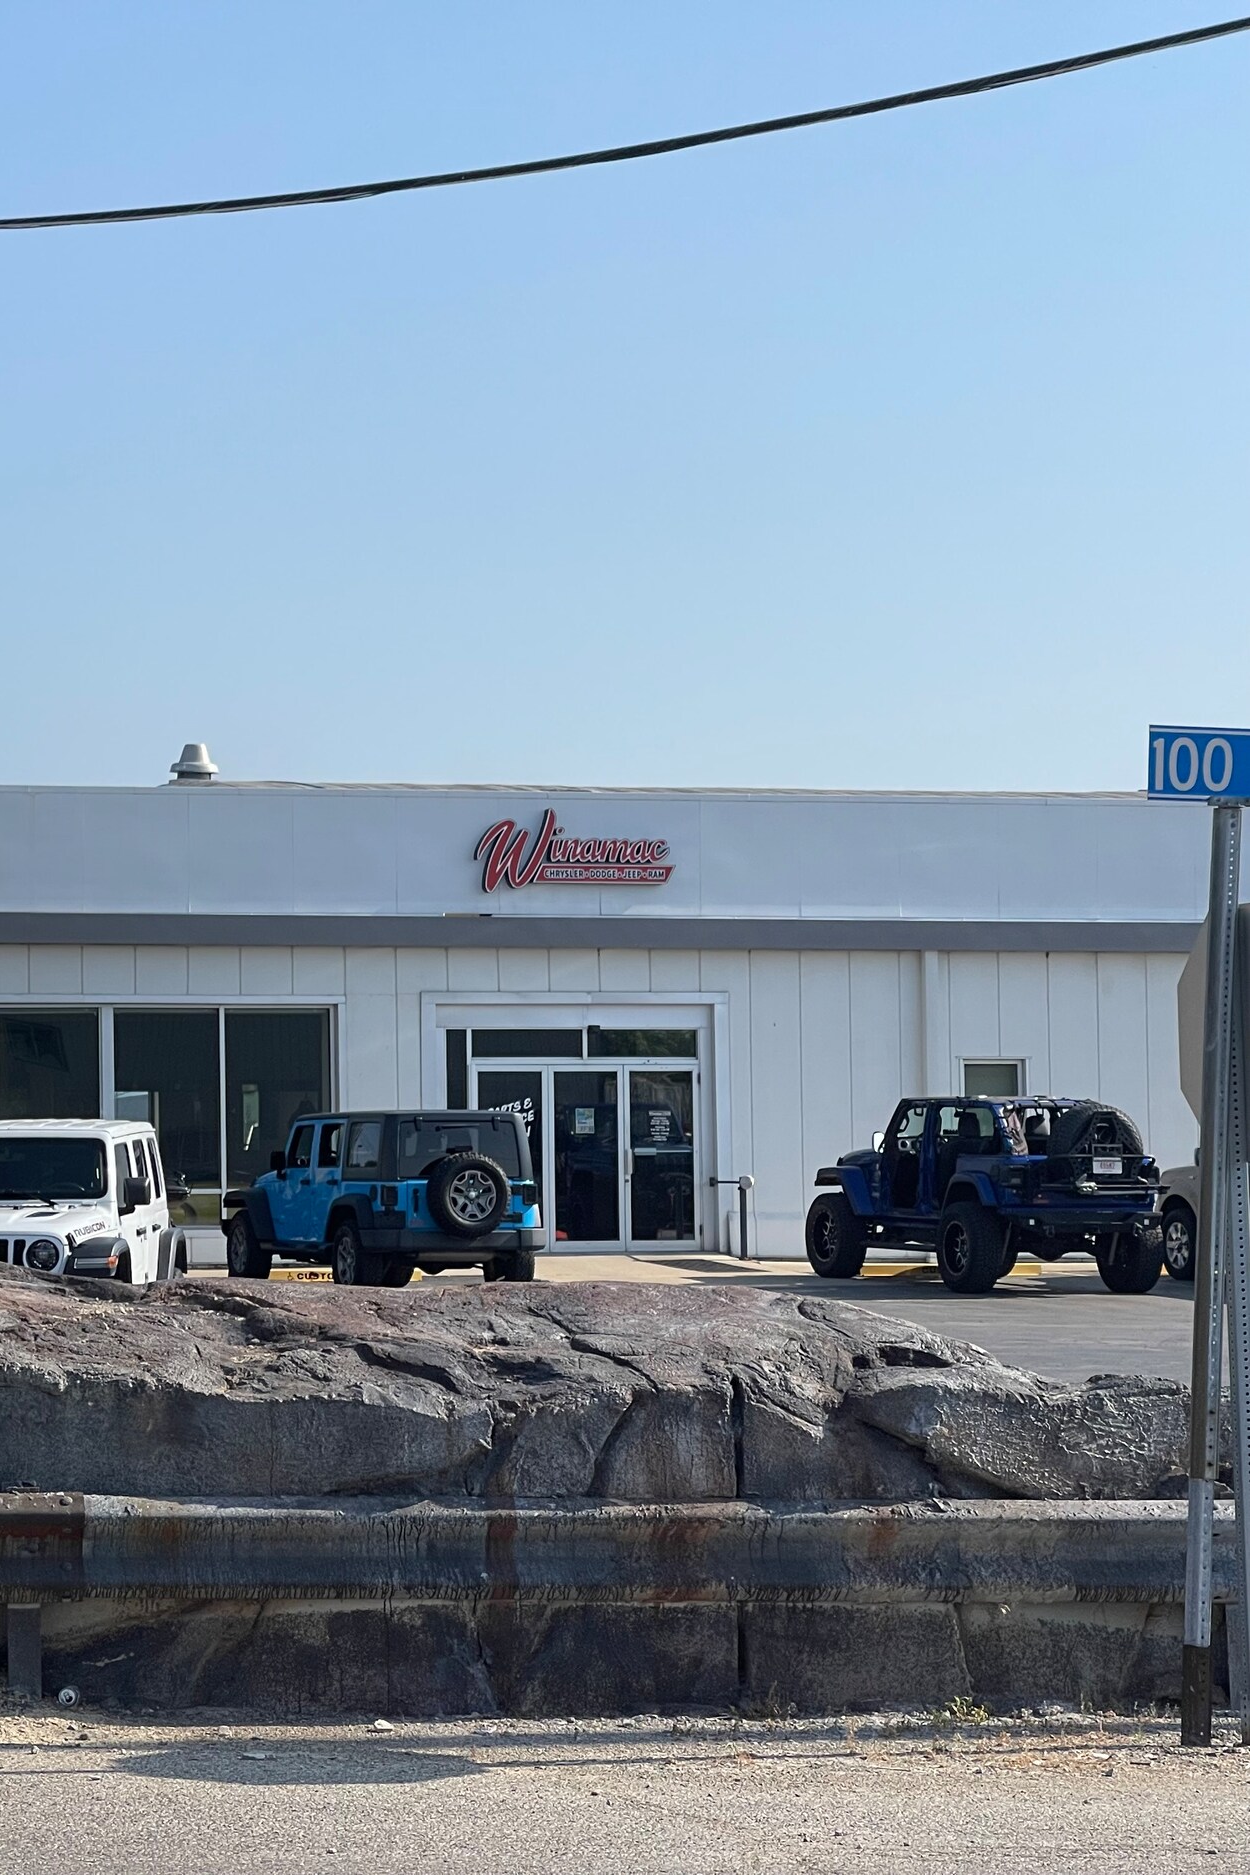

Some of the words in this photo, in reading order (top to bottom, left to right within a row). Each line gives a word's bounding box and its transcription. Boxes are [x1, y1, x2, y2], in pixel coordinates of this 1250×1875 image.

[1153, 737, 1233, 792] 100
[474, 808, 670, 893] Winamac
[544, 868, 584, 879] CHRYSLER
[590, 868, 617, 879] DODGE
[623, 868, 642, 879] JEEP
[647, 868, 665, 879] RAM
[523, 1097, 532, 1109] &
[73, 1221, 105, 1237] RUBICON
[297, 1272, 333, 1280] CUSTO
